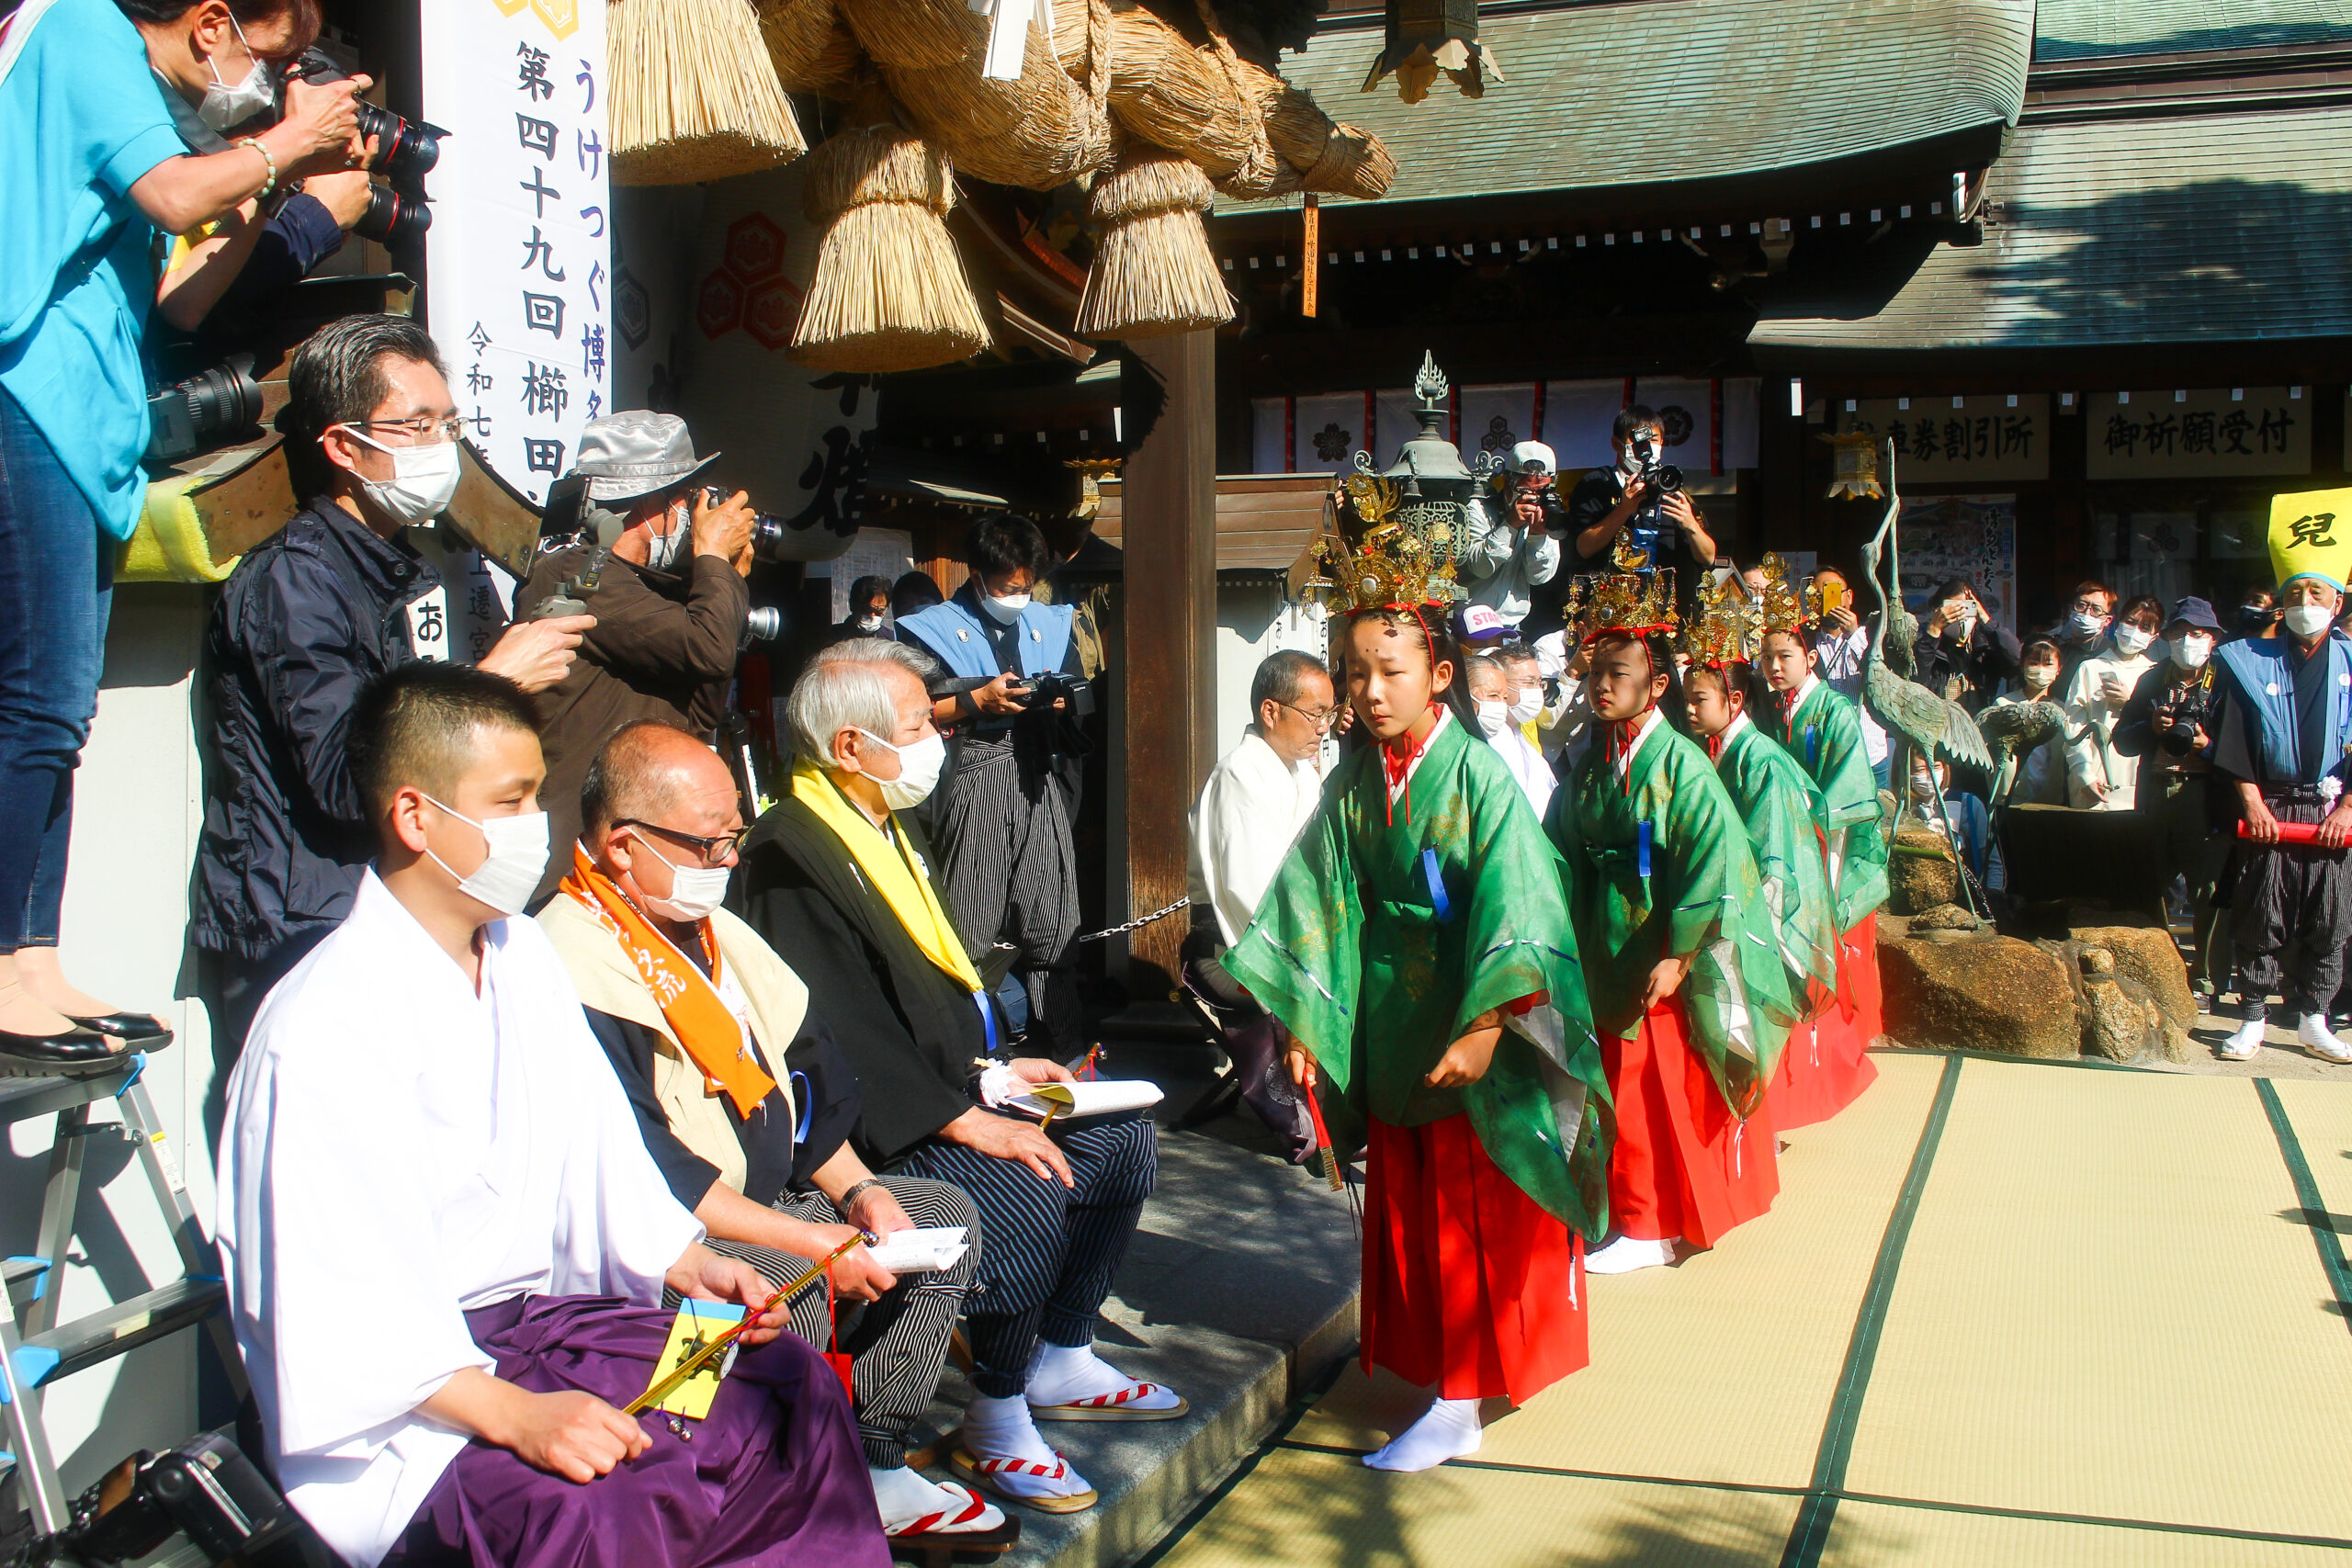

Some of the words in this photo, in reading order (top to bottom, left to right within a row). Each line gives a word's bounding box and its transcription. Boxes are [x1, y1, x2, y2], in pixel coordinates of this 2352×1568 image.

[516, 40, 569, 502] 第四十九回櫛田
[1854, 416, 2034, 462] 車券割引所
[2104, 407, 2295, 457] 御祈願受付
